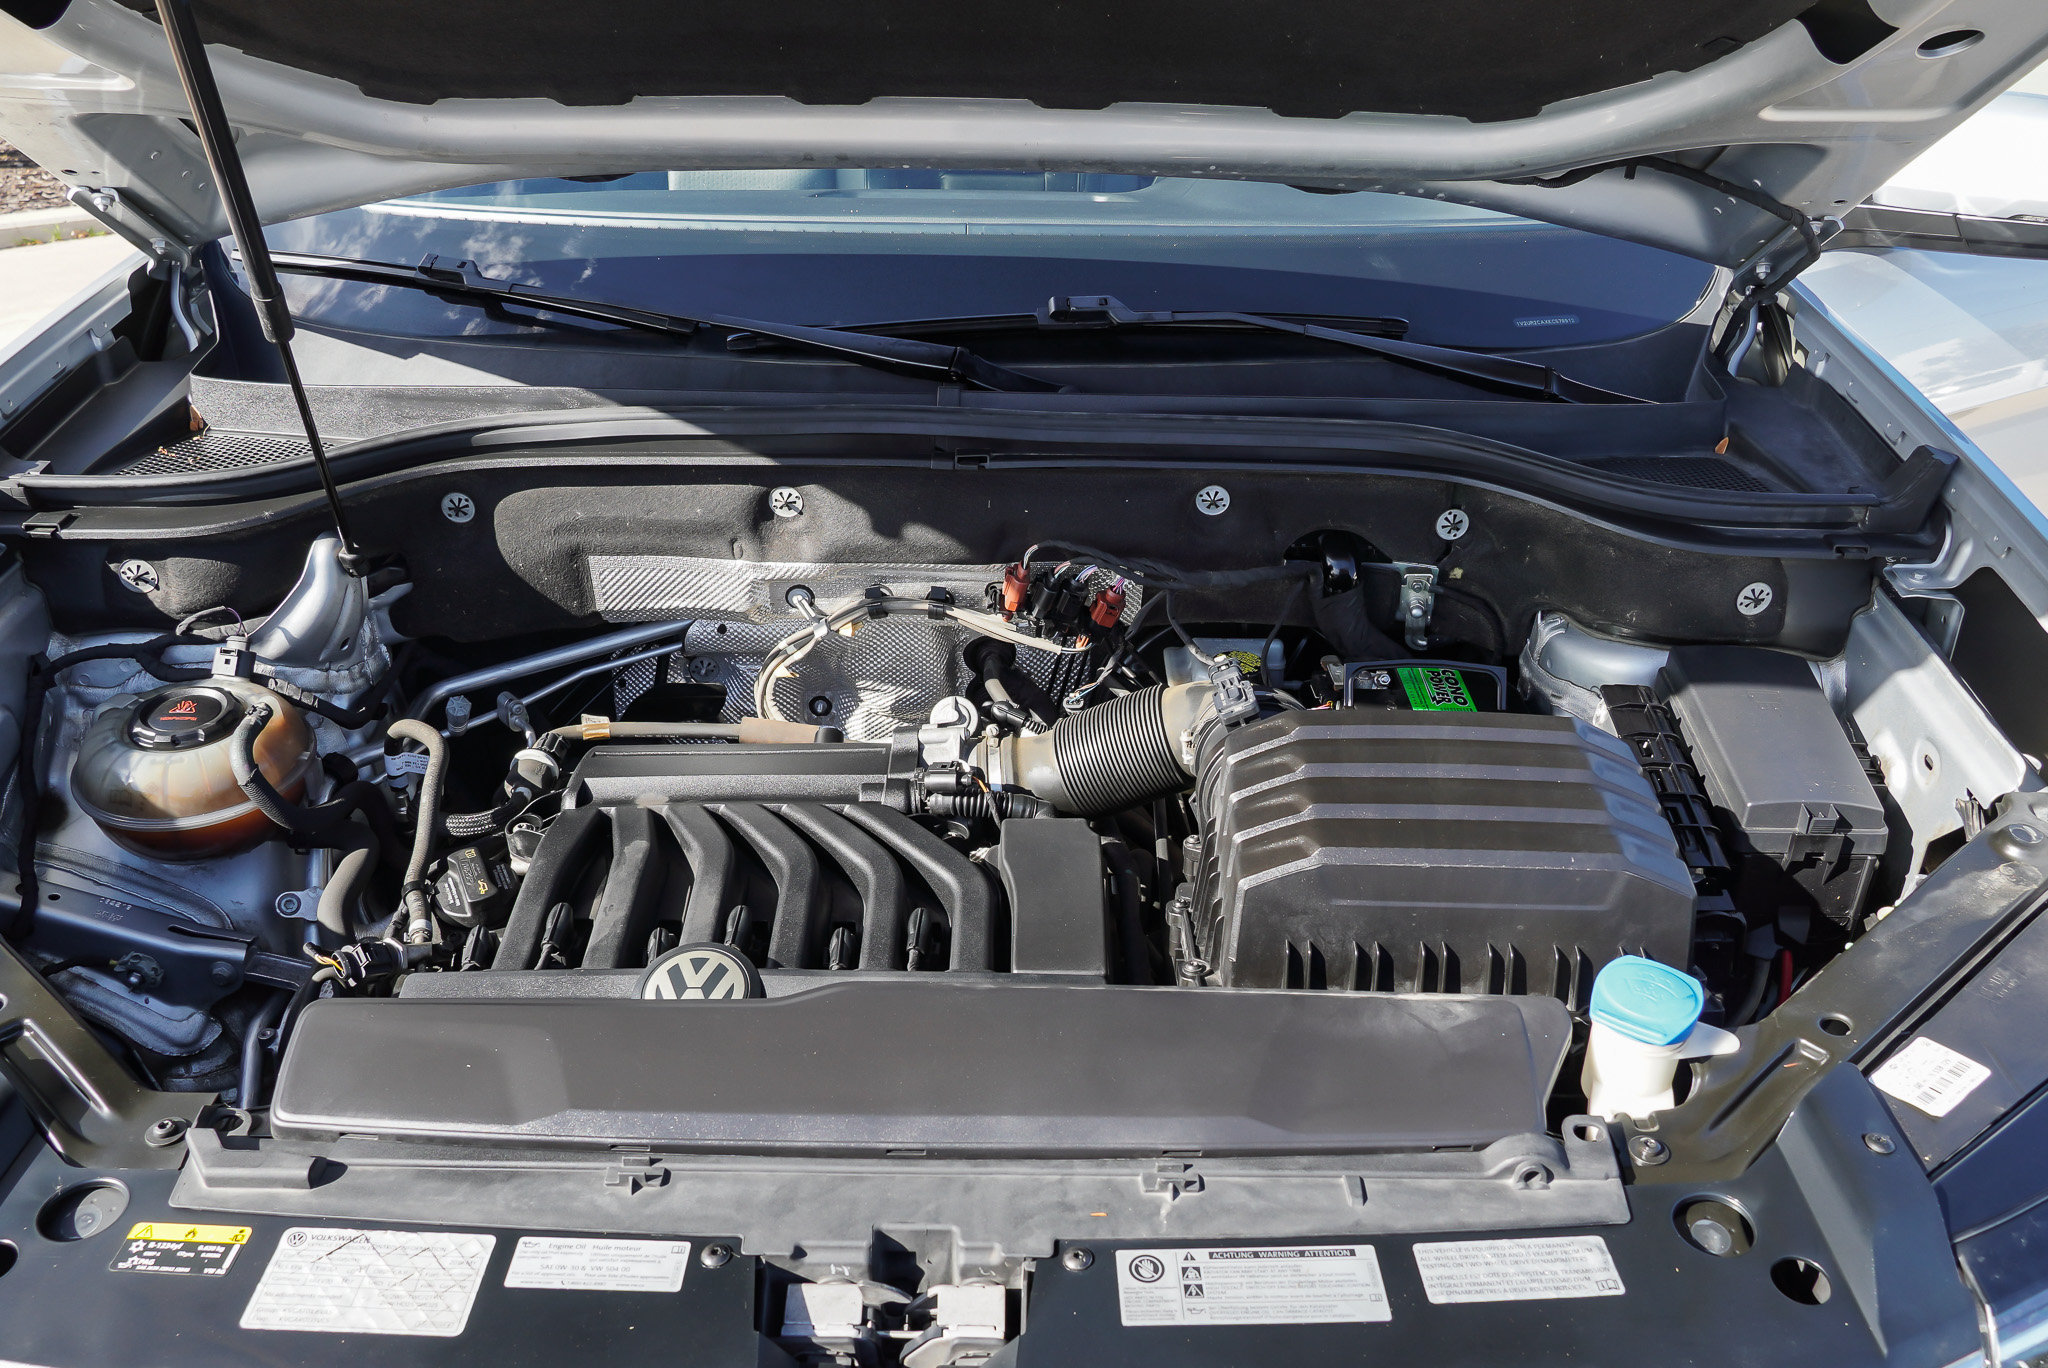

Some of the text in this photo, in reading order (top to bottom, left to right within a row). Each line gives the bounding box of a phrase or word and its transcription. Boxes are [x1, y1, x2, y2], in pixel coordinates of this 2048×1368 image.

[1425, 670, 1453, 704] POWER
[311, 1234, 371, 1244] VOLKSWAGEN
[1463, 1279, 1505, 1287] PERMANENT
